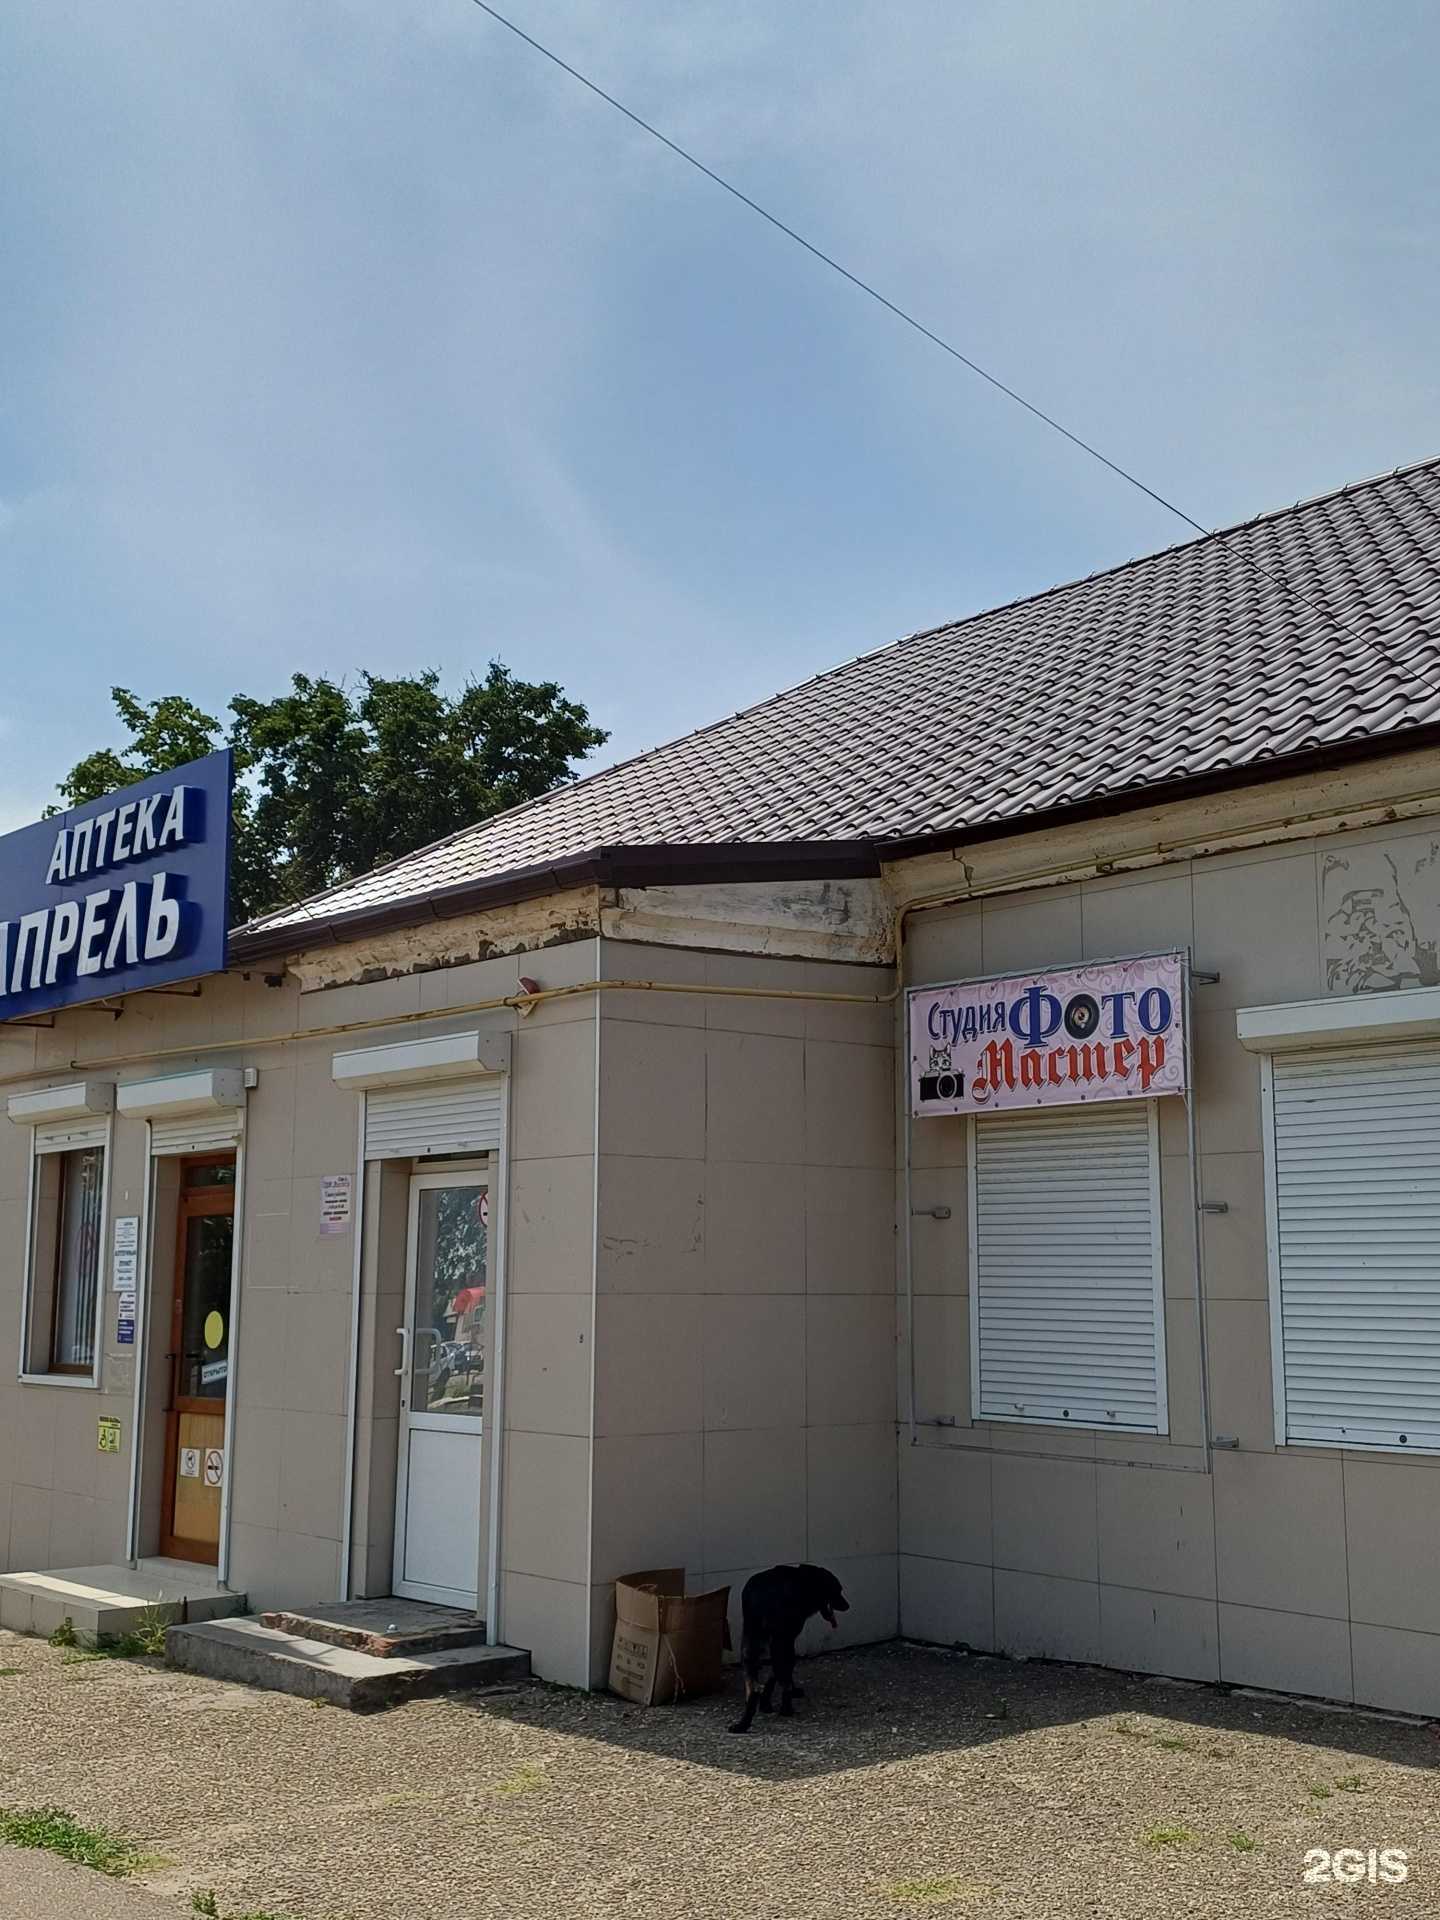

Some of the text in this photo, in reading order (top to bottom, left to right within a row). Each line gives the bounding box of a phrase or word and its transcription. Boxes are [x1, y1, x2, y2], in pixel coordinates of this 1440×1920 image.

[46, 785, 186, 884] АПТЕКА
[928, 1001, 1007, 1047] Студия
[971, 1035, 1168, 1104] Мастер
